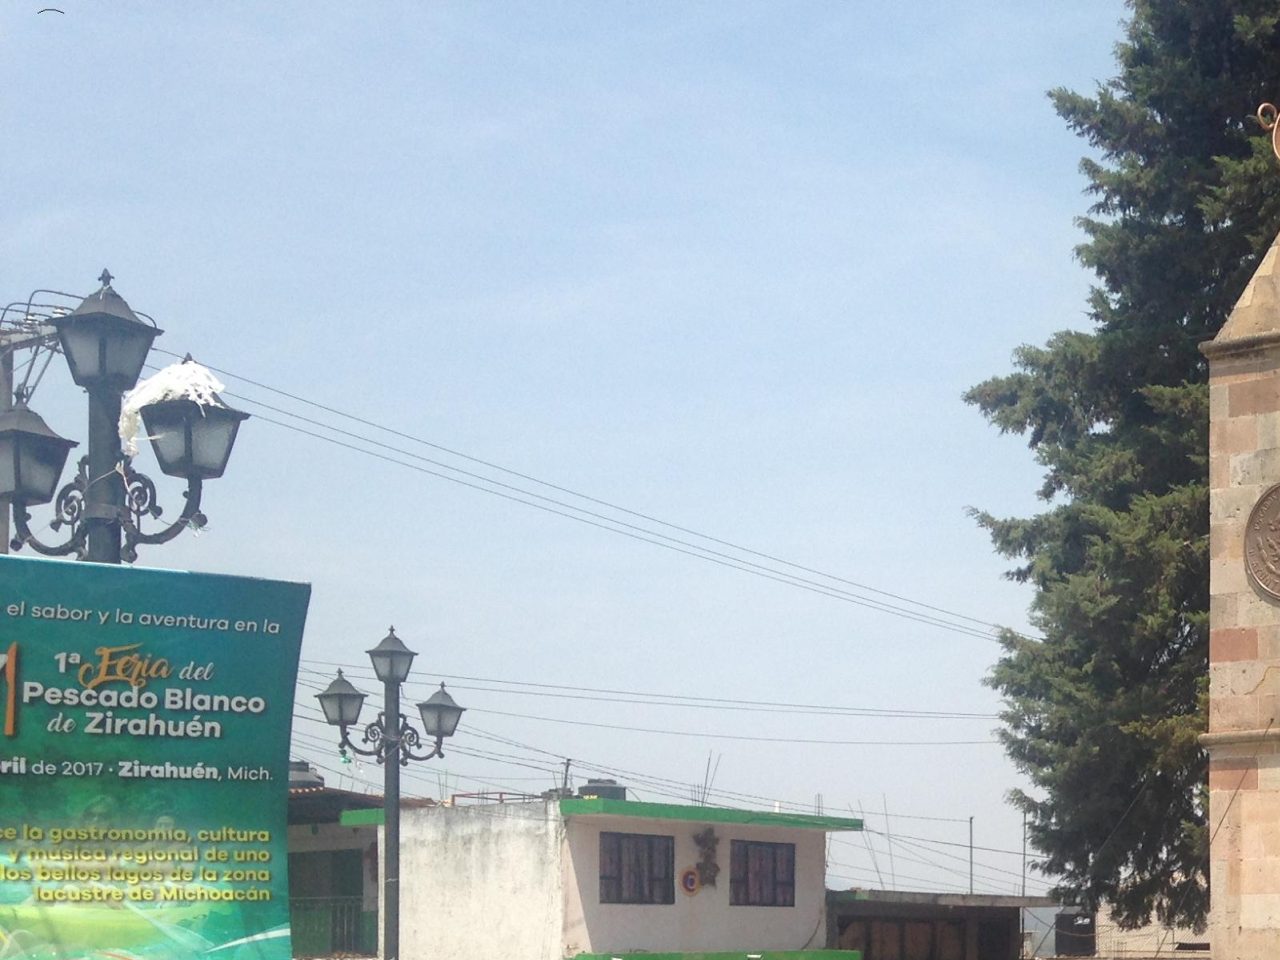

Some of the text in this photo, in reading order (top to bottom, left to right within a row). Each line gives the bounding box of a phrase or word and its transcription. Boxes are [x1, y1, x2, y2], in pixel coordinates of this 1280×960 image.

[7, 601, 280, 634] el sabor y la aventura en la
[78, 642, 174, 689] Feria
[178, 661, 214, 681] del
[23, 681, 266, 713] Pescado Blanco
[46, 711, 222, 738] de Zirahuén
[31, 760, 57, 775] de
[61, 761, 104, 776] 2017
[118, 760, 222, 781] Zirahuén,
[227, 766, 274, 781] Mich.
[23, 824, 43, 840] la
[197, 827, 270, 842] cultura
[8, 850, 20, 864] y
[112, 847, 198, 865] regional
[204, 848, 229, 862] de
[234, 849, 270, 862] uno
[0, 864, 270, 885] los bellos lagos de la zona
[35, 886, 271, 901] lacustre de Michoacán
